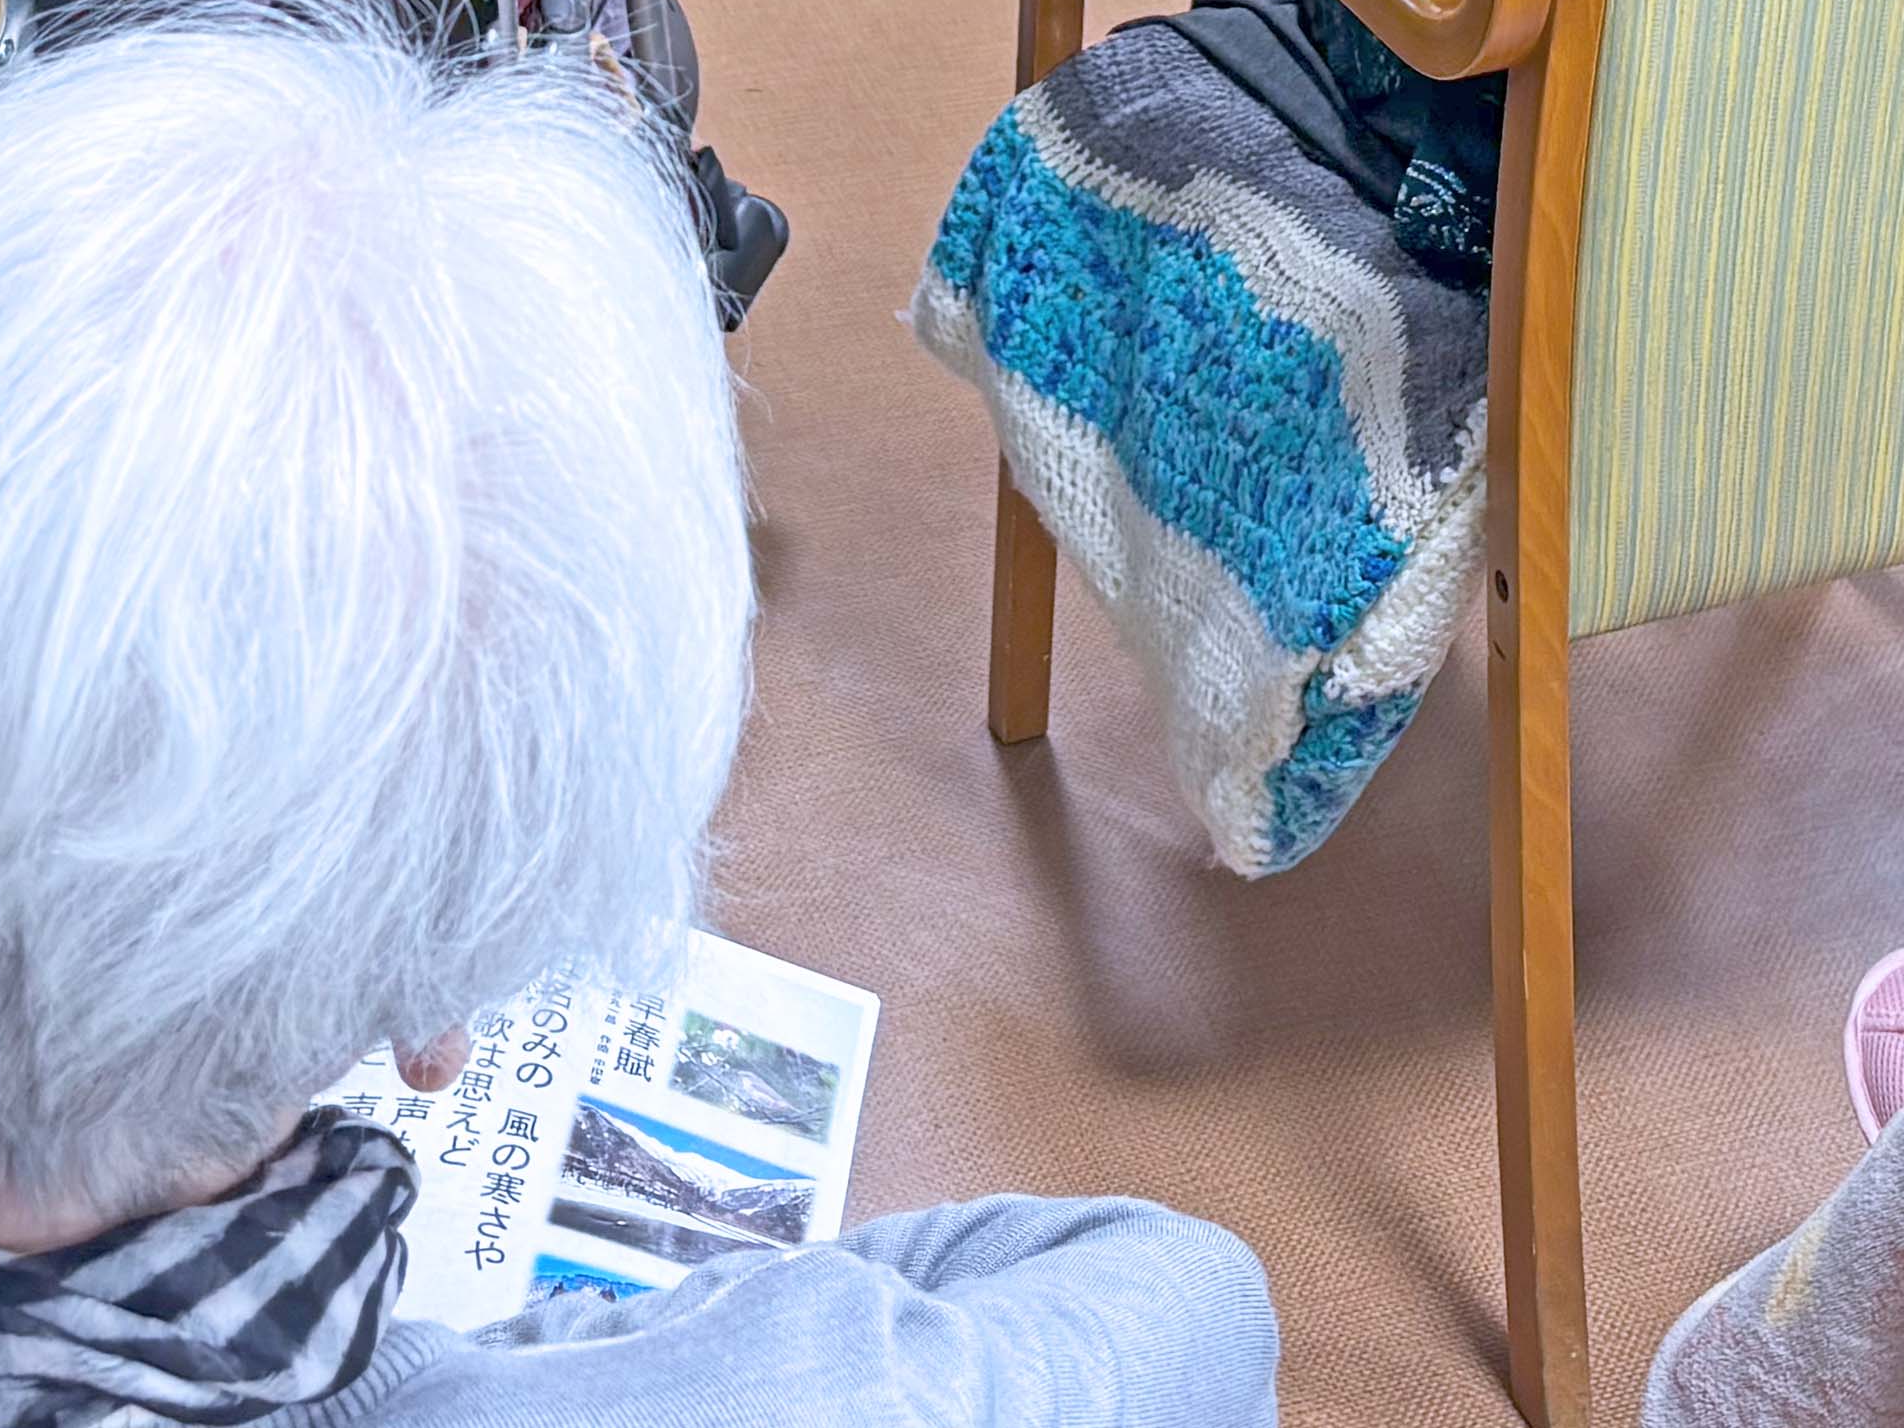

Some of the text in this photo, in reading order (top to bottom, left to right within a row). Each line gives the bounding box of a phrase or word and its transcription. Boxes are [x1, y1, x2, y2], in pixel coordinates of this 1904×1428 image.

[438, 1012, 516, 1169] 歌は思えど
[612, 991, 667, 1083] 早春賦
[464, 1107, 539, 1271] 風の寒さや
